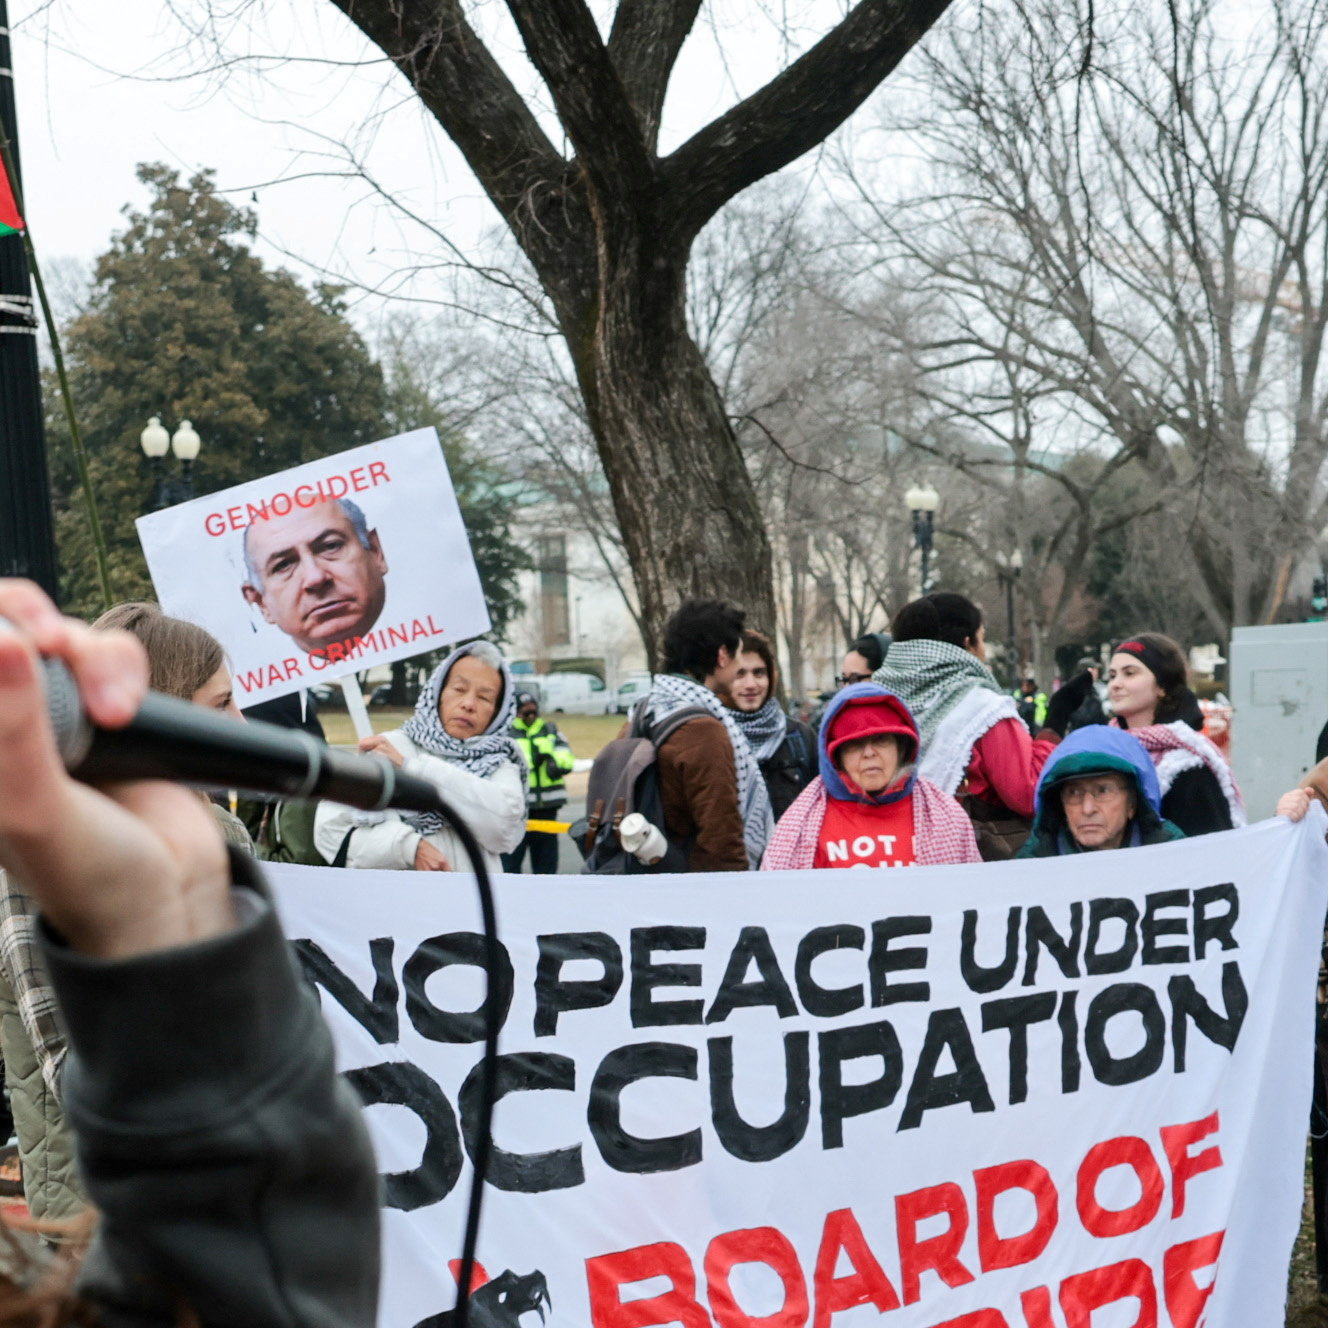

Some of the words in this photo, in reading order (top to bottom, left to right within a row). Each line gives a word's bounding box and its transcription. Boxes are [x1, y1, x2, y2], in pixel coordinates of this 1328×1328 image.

[204, 460, 392, 538] GENOCIDER
[237, 655, 304, 694] WAR
[308, 614, 445, 671] CRIMINAL
[826, 835, 897, 862] NOT
[288, 931, 515, 1044] NO
[534, 915, 932, 1038] PEACE
[960, 882, 1240, 994] UNDER
[340, 961, 1249, 1212] OCCUPATION
[1076, 1110, 1224, 1239] OF
